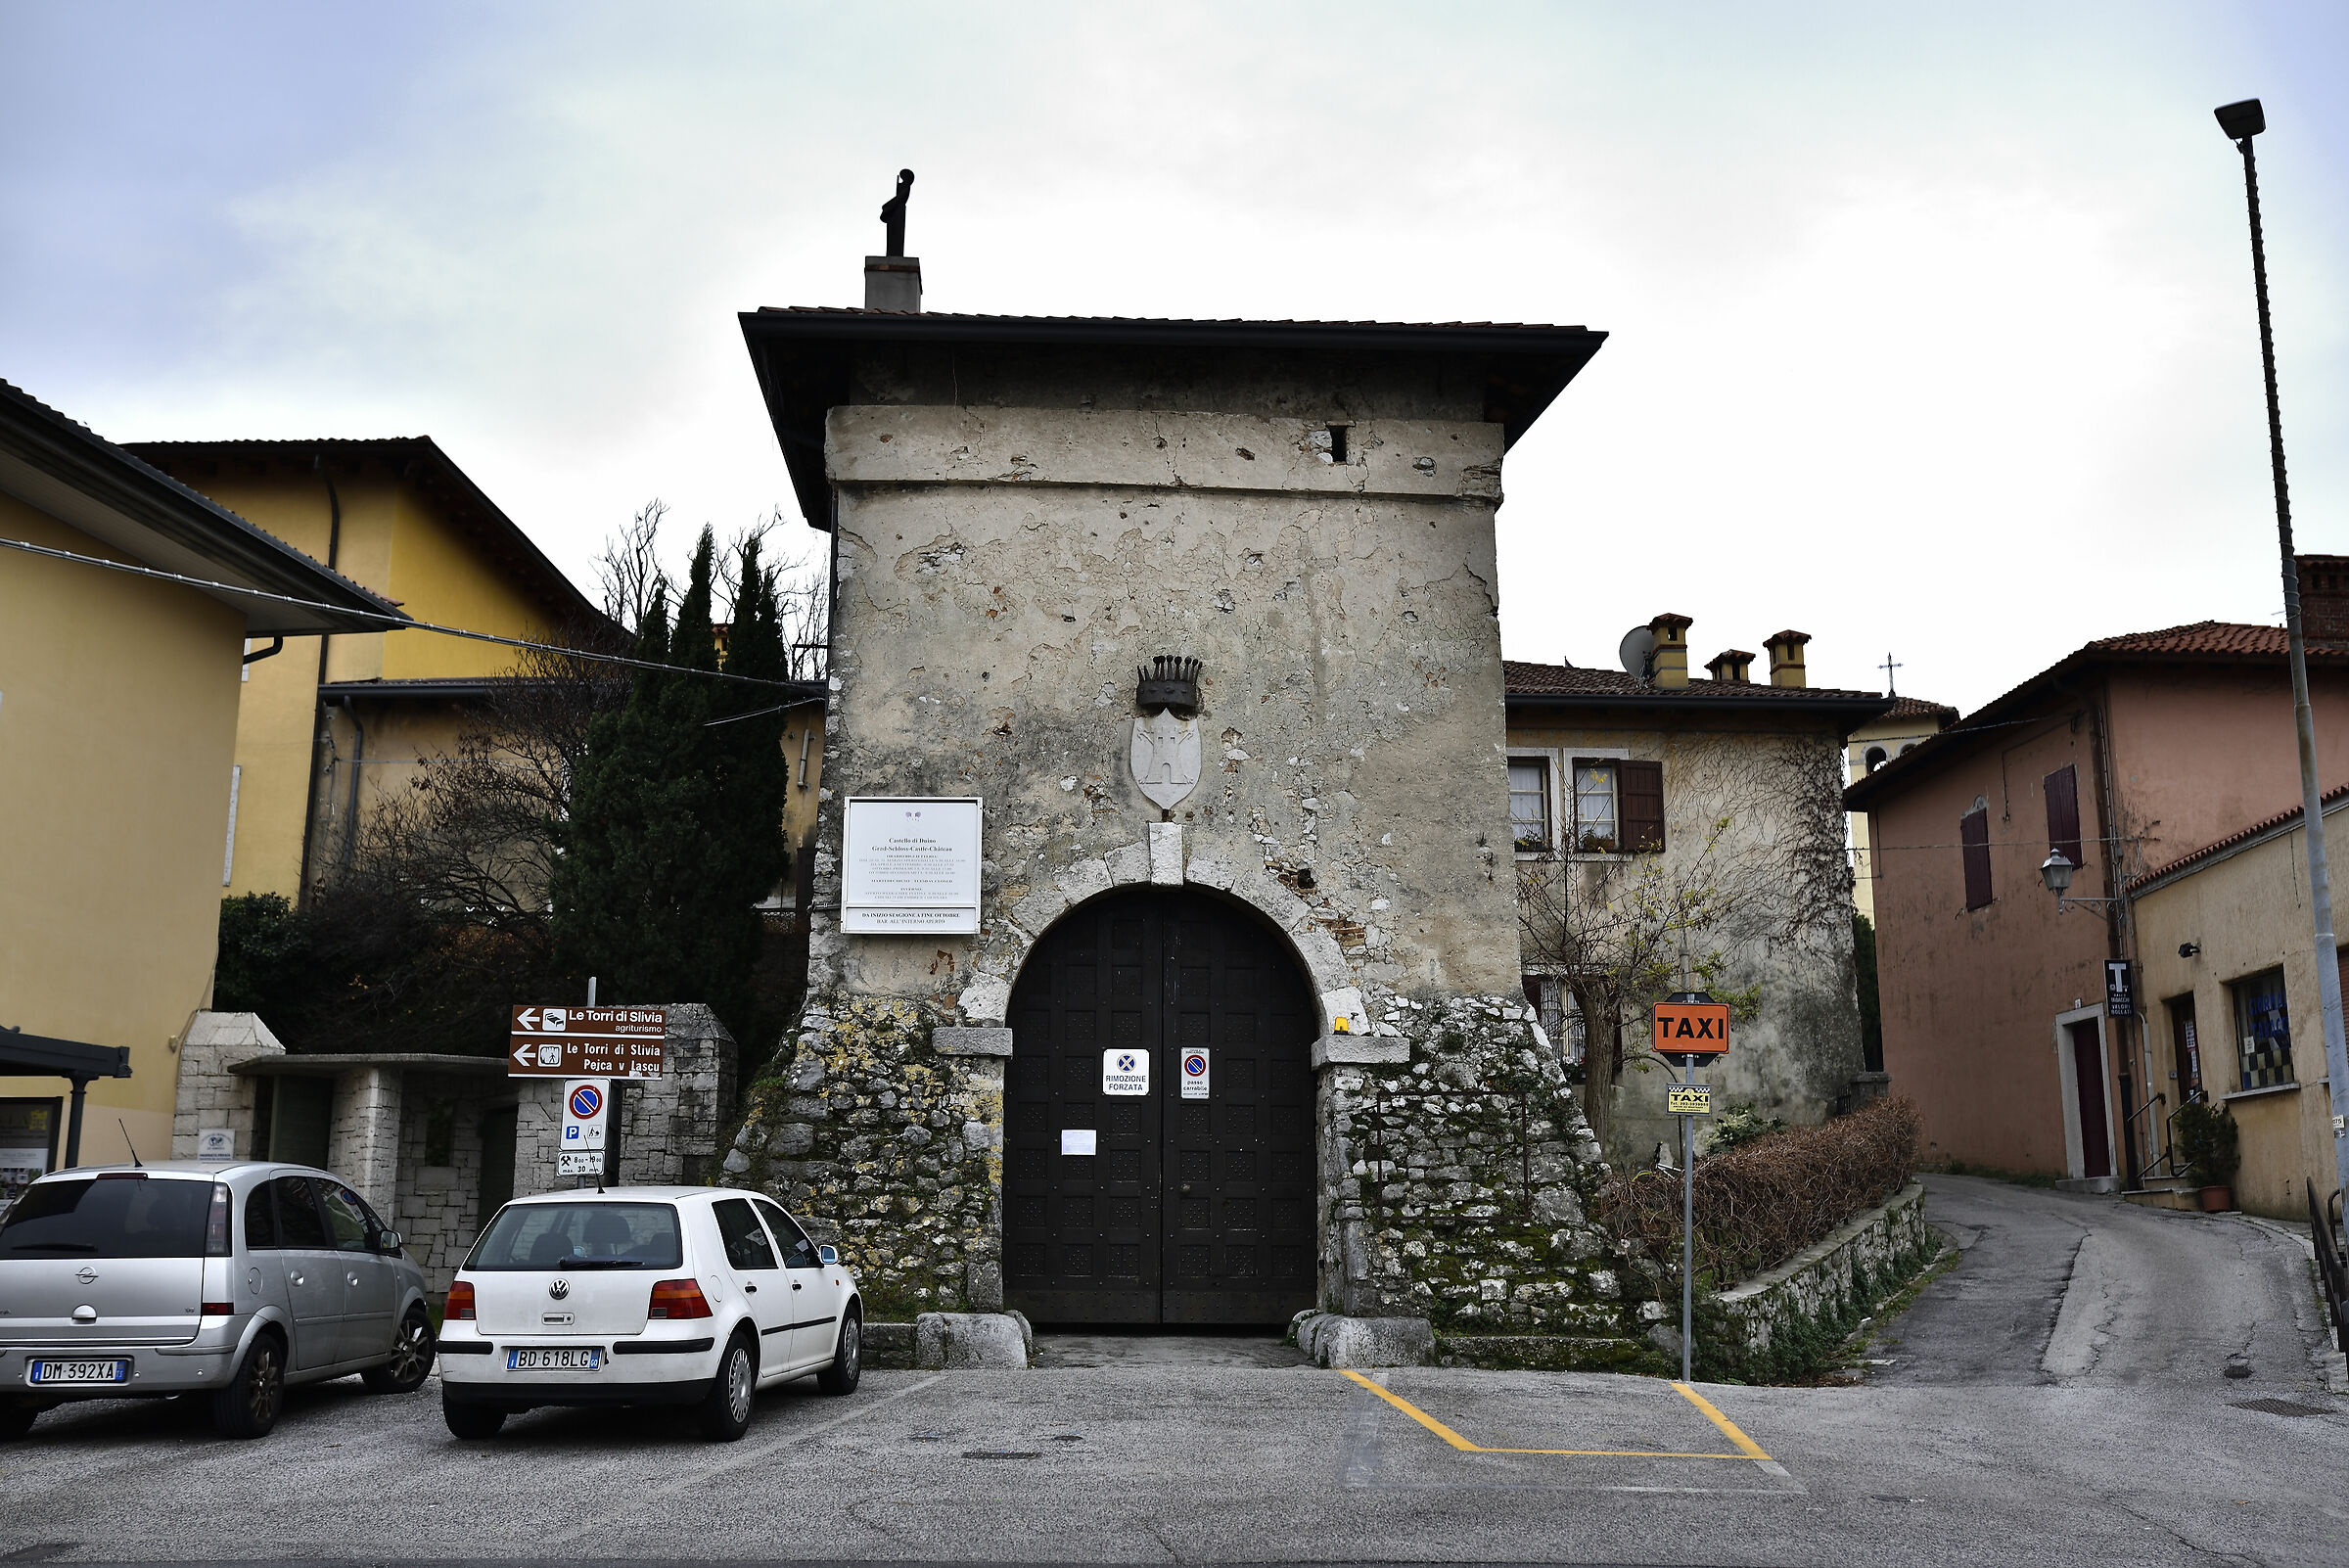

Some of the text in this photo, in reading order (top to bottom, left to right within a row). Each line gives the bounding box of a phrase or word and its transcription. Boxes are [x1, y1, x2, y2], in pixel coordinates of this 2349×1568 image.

[2109, 963, 2126, 992] T
[569, 1010, 662, 1023] Le Torri di Slivia
[615, 1025, 662, 1033] agriturismo
[1657, 1017, 1723, 1039] TAXI
[567, 1043, 660, 1056] Le Torri di Slivia
[584, 1059, 612, 1071] Pejca
[631, 1060, 659, 1072] Lascu
[1671, 1094, 1708, 1102] TAXI
[569, 1127, 577, 1138] P
[519, 1351, 537, 1366] BD
[542, 1351, 589, 1366] 618LG
[43, 1363, 63, 1379] DM
[68, 1363, 113, 1379] 392XA
